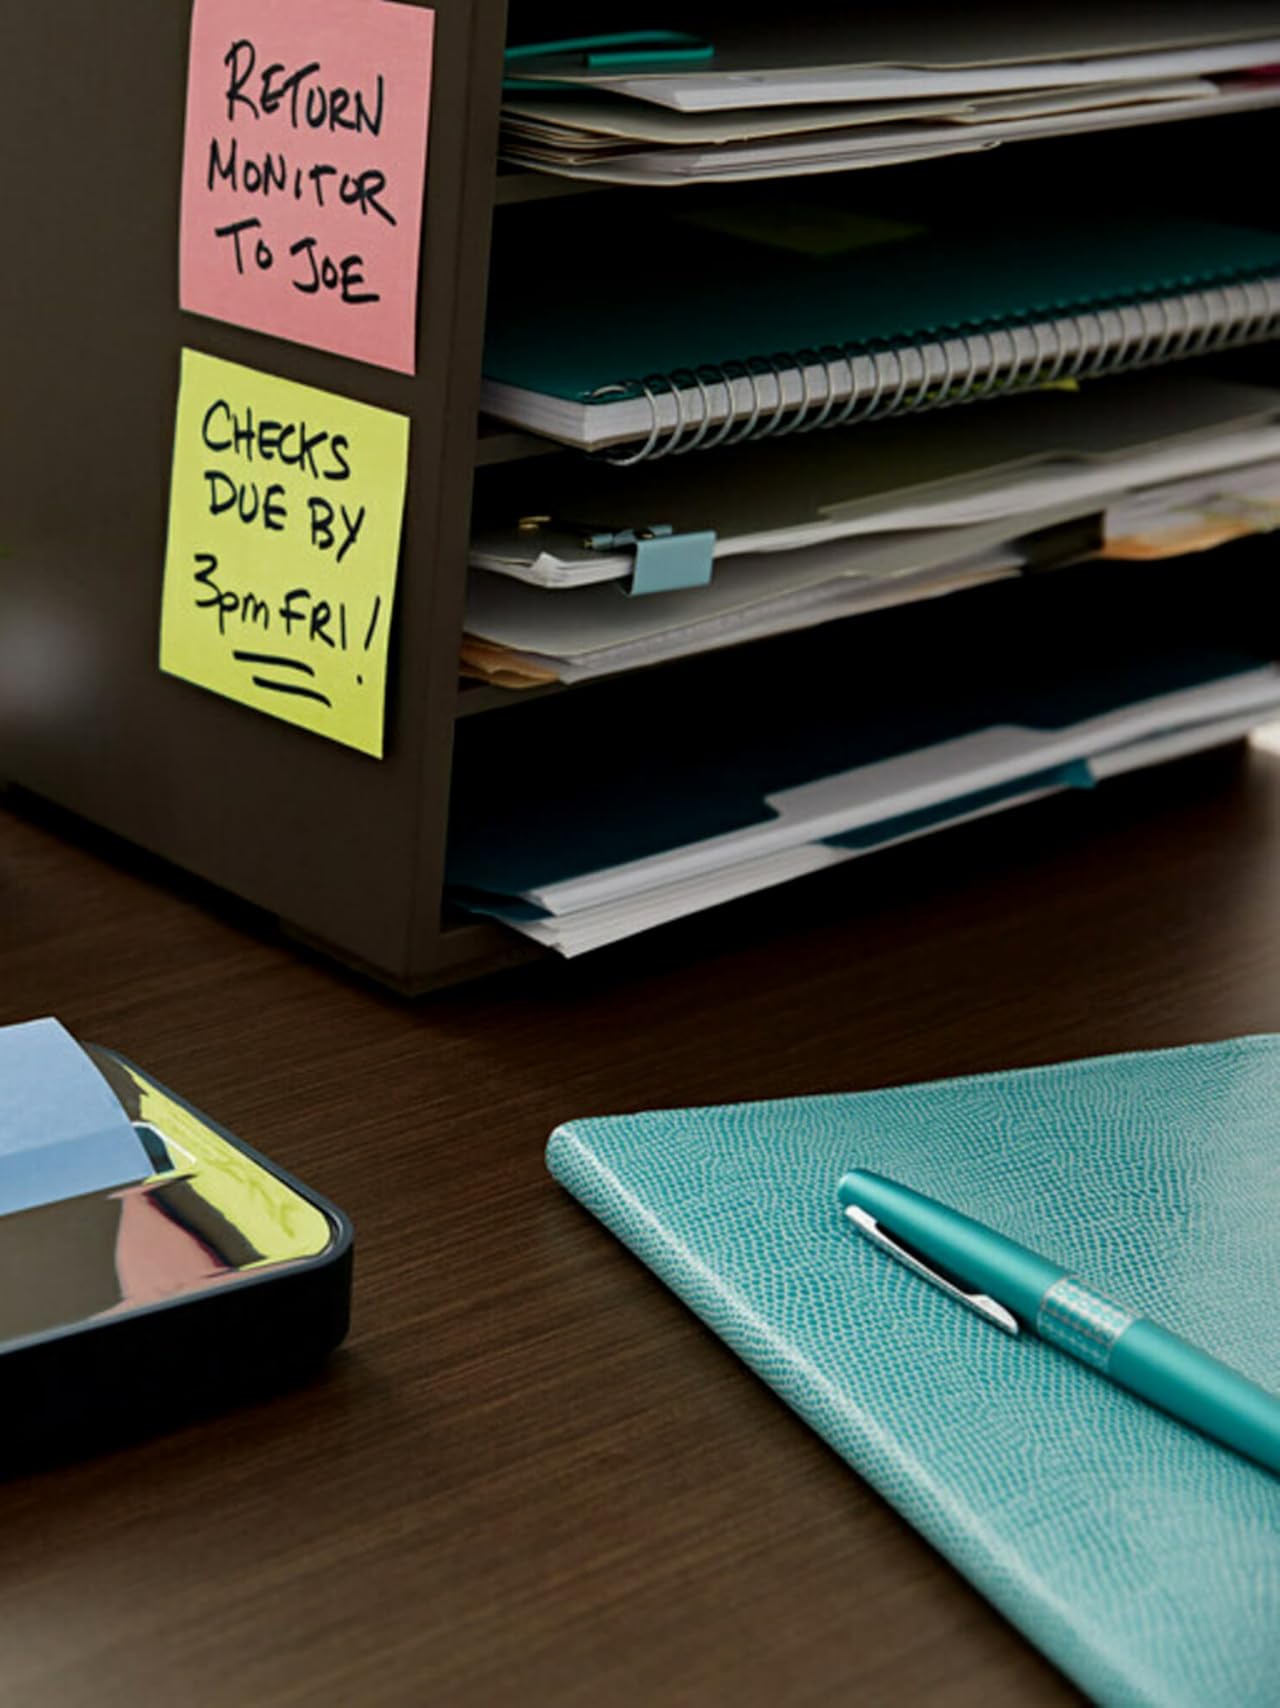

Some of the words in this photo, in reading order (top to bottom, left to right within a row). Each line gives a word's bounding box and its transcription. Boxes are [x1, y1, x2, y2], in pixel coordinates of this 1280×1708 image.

[224, 39, 384, 136] RETURN
[207, 137, 397, 226] MONITOR
[215, 217, 273, 275] TO
[289, 237, 380, 304] JOE
[202, 399, 351, 480] CHECKS
[204, 470, 288, 530] DUE
[306, 496, 366, 563] BY
